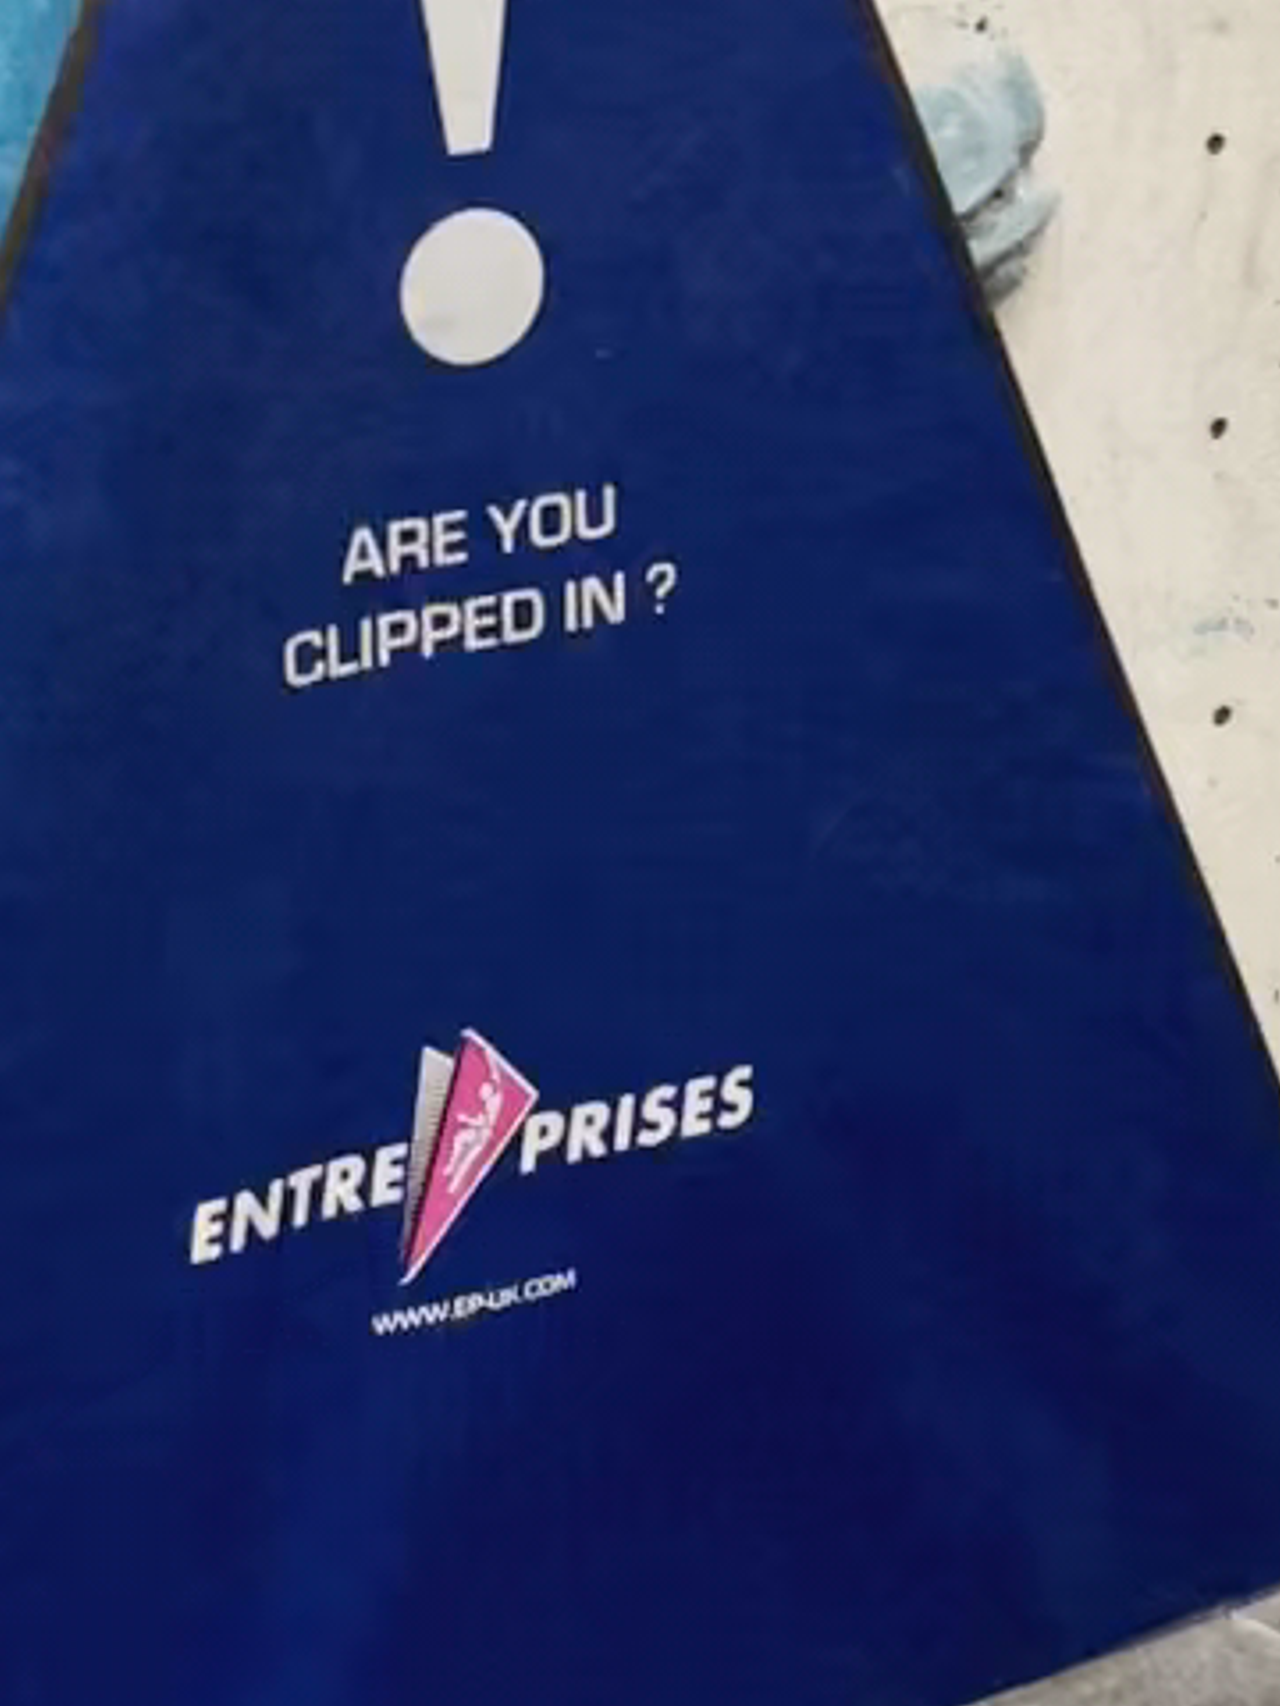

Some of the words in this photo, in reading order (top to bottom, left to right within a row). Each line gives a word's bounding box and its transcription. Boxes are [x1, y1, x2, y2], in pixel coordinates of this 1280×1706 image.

[341, 508, 469, 586] ARE
[485, 484, 616, 555] YOU
[283, 587, 546, 689] CLIPPED
[563, 570, 627, 633] IN
[644, 561, 678, 615] ?
[189, 1141, 410, 1266] ENTRE
[519, 1064, 755, 1174] PRISES
[371, 1268, 577, 1336] WWW.EP-UK.COM
